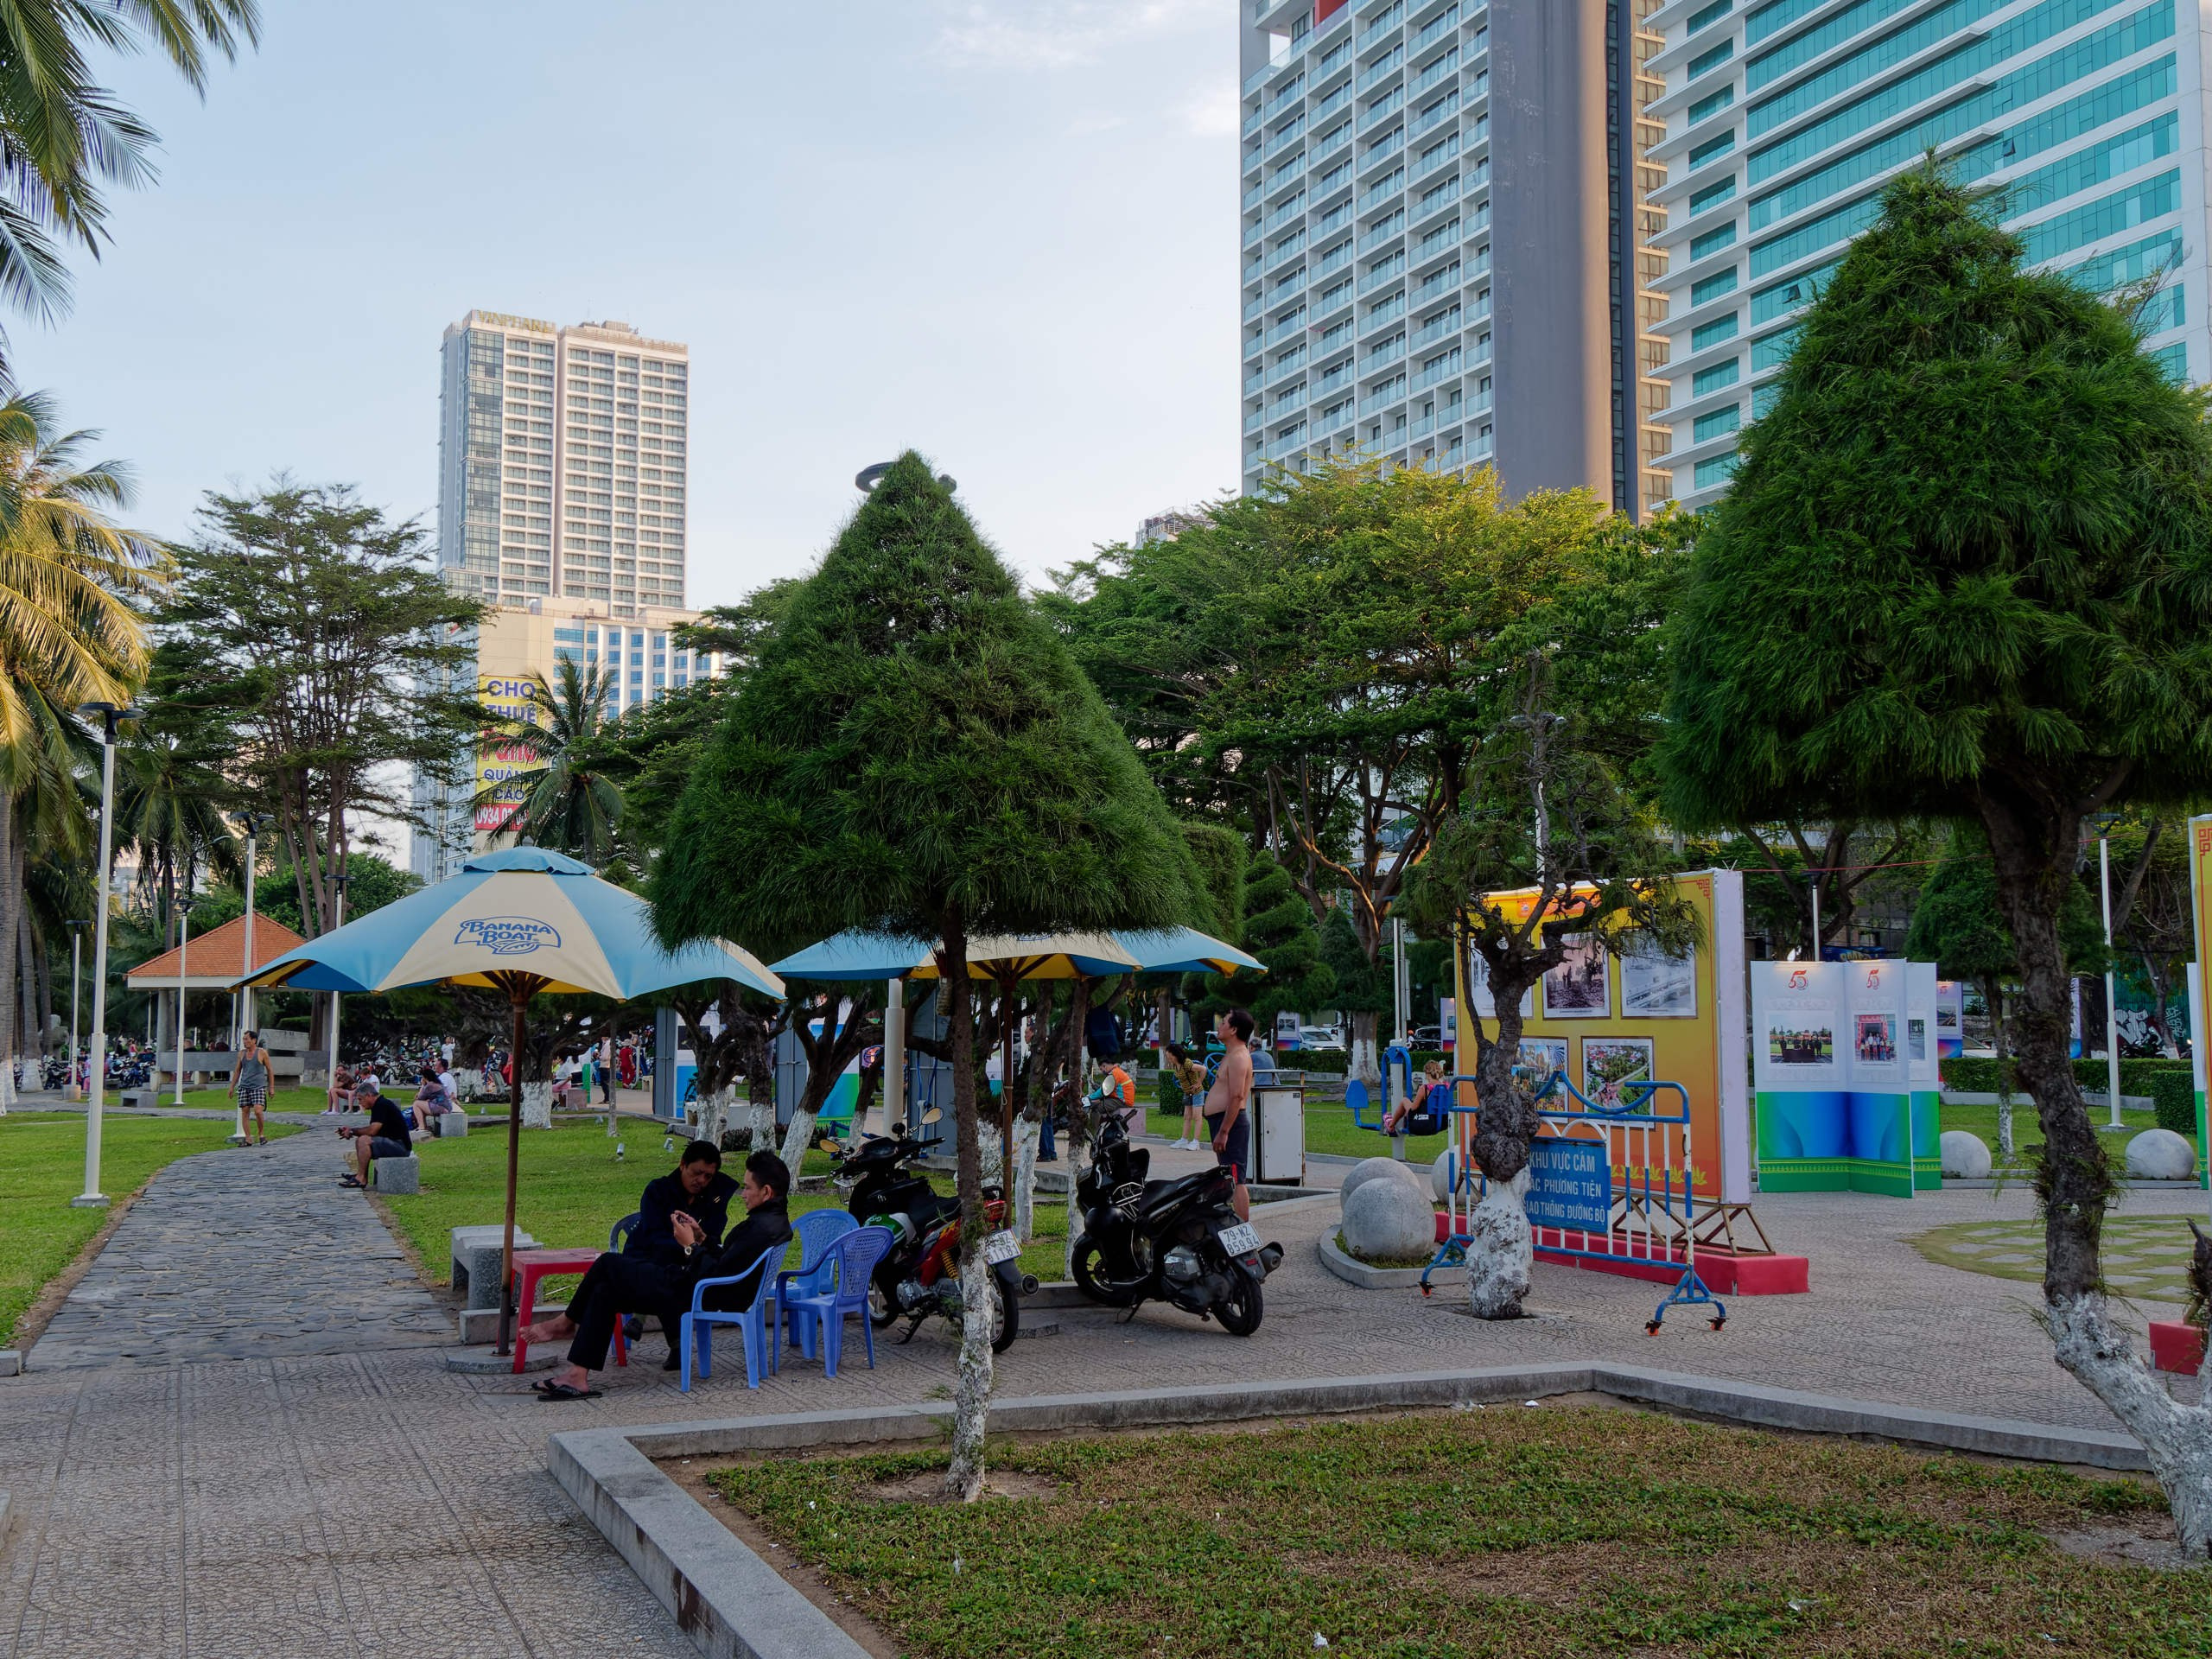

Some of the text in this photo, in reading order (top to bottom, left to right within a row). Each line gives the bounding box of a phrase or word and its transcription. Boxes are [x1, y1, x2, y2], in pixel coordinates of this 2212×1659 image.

[487, 680, 536, 698] CHO
[484, 766, 534, 781] QUẢN
[463, 921, 551, 935] BANANA
[479, 931, 537, 944] BOAT
[1529, 1151, 1548, 1169] KHU
[1530, 1175, 1541, 1192] ÁC
[1581, 1179, 1602, 1199] TIỆN
[1525, 1200, 1540, 1215] IAO
[1541, 1199, 1565, 1217] THÔNG
[1594, 1205, 1605, 1225] BỘ
